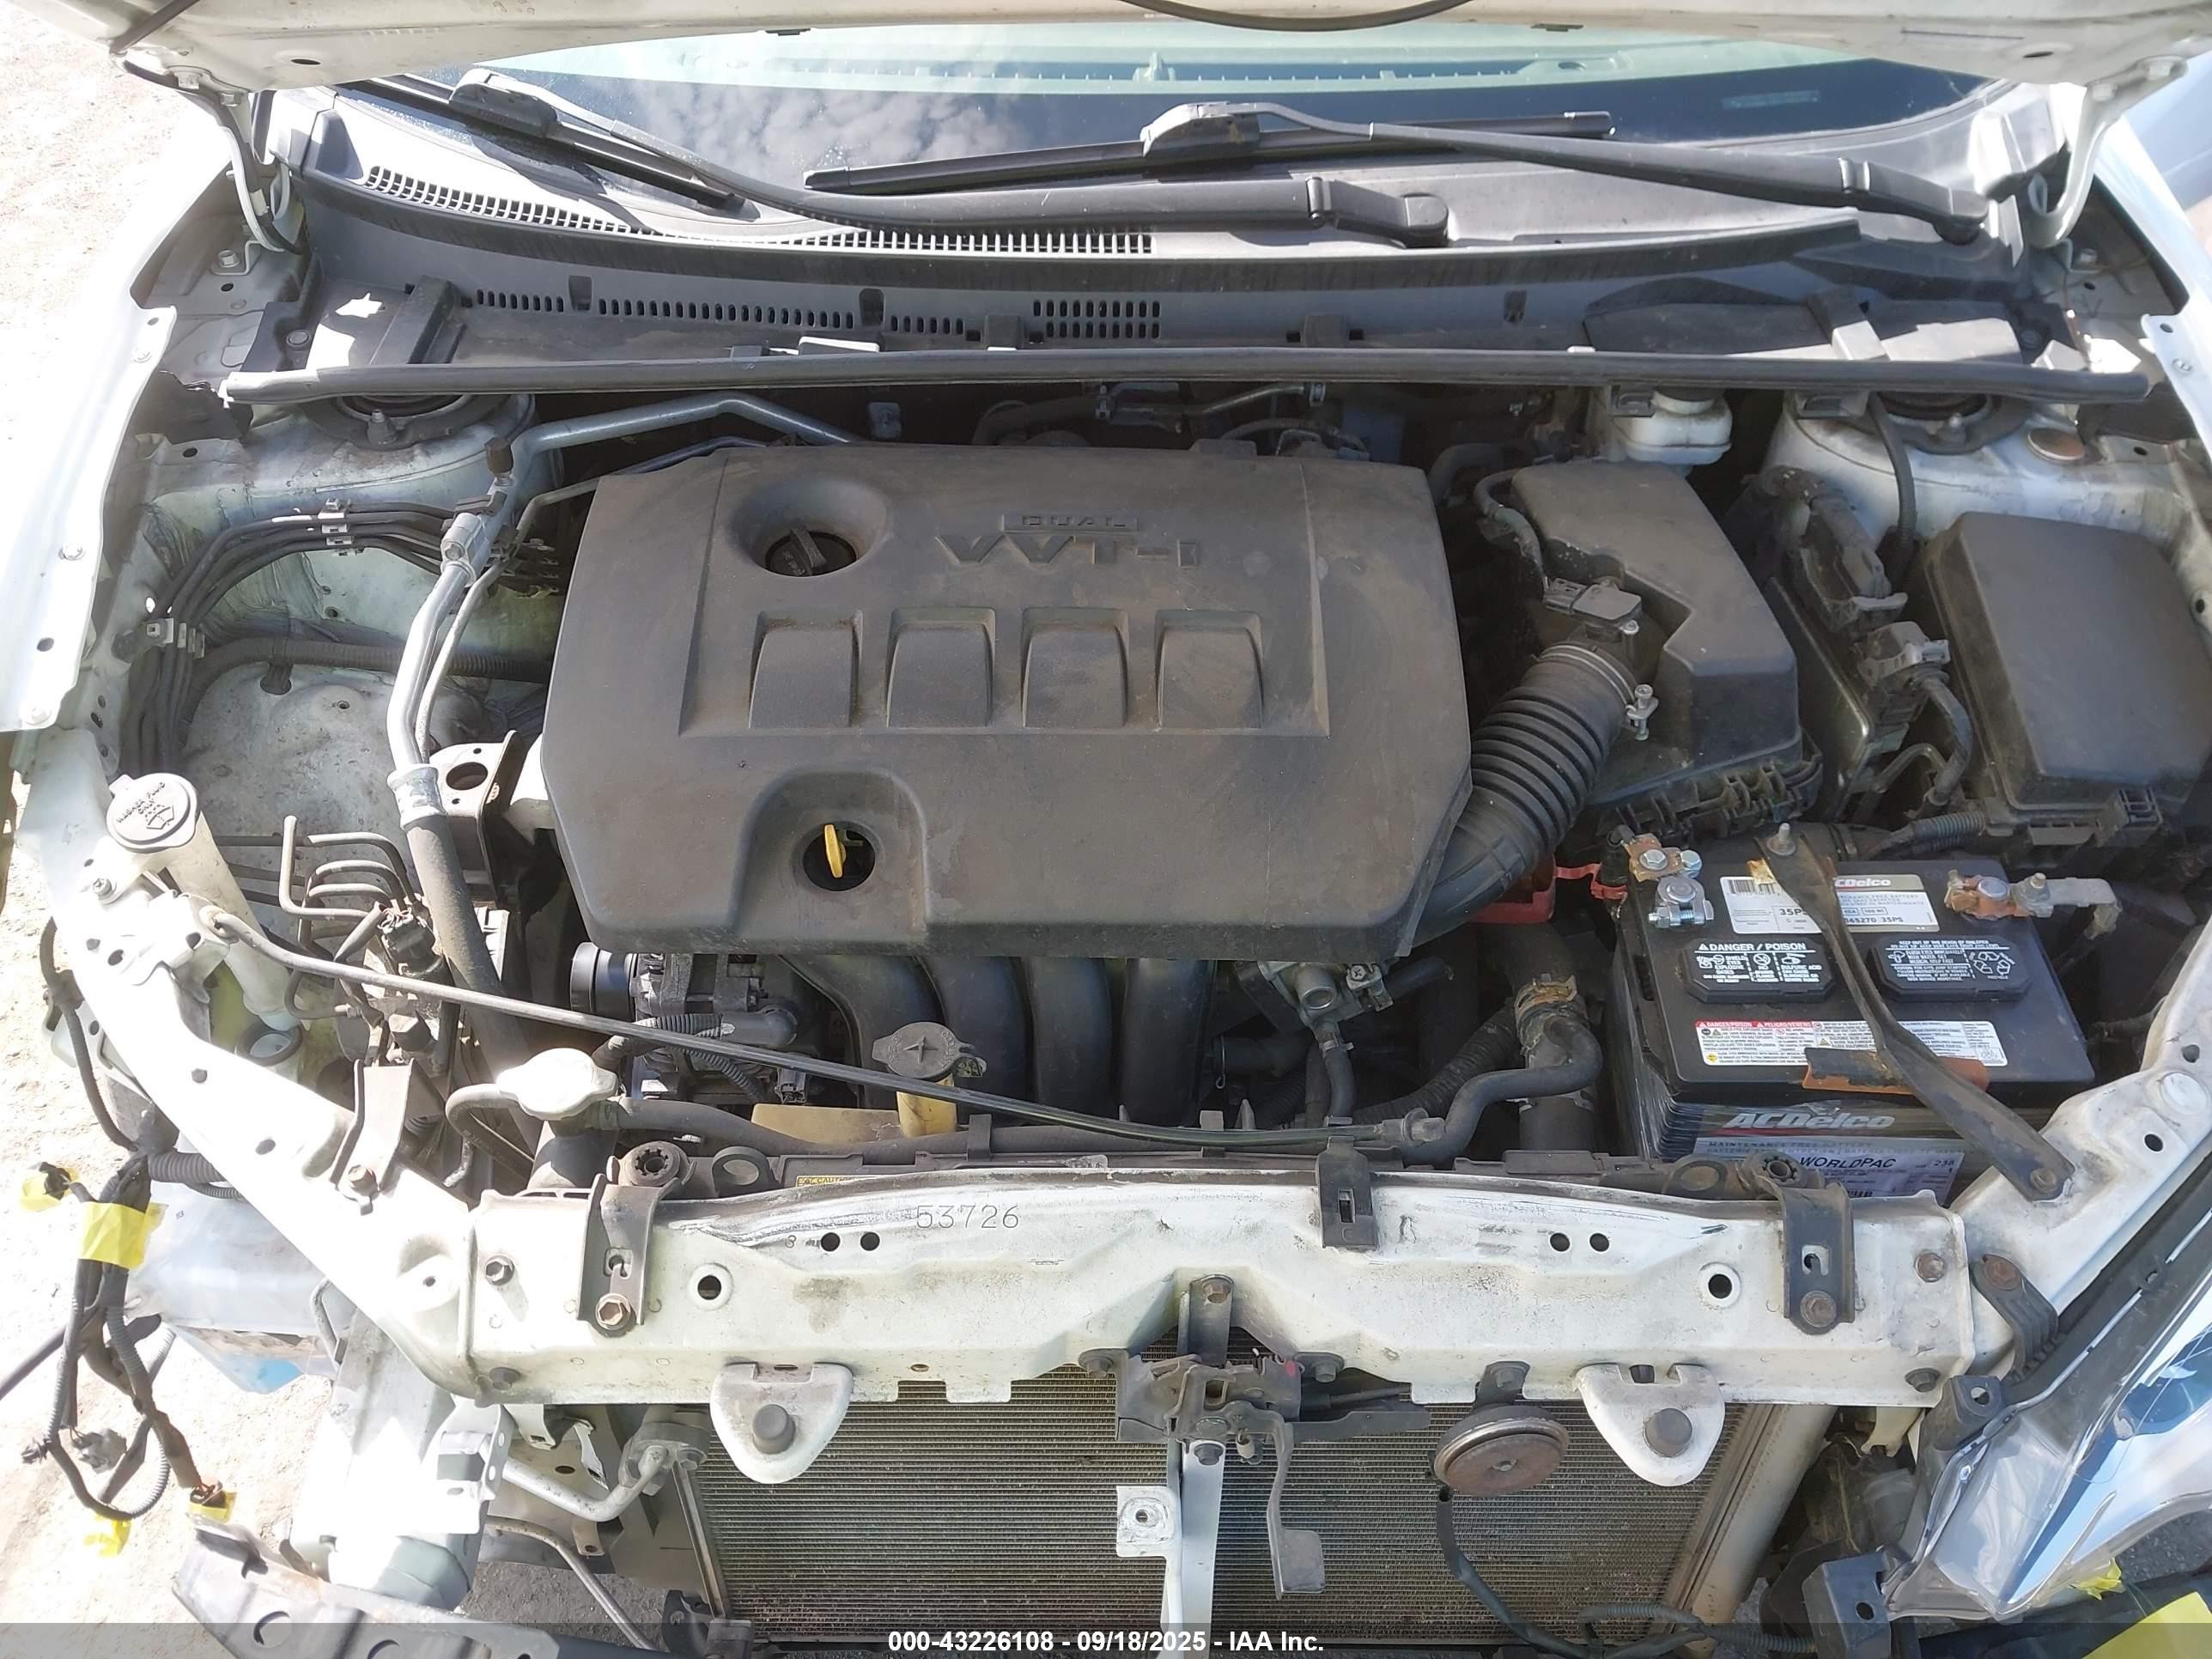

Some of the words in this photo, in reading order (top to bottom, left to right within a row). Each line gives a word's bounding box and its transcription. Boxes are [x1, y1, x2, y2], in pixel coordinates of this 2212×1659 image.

[1022, 515, 1127, 527] DUAL
[1709, 943, 1755, 951] DANGER
[1765, 942, 1808, 951] POISON
[1723, 1112, 1896, 1129] ACDelco
[1800, 1157, 1897, 1169] WORLDPAC
[916, 1205, 1019, 1230] 53726
